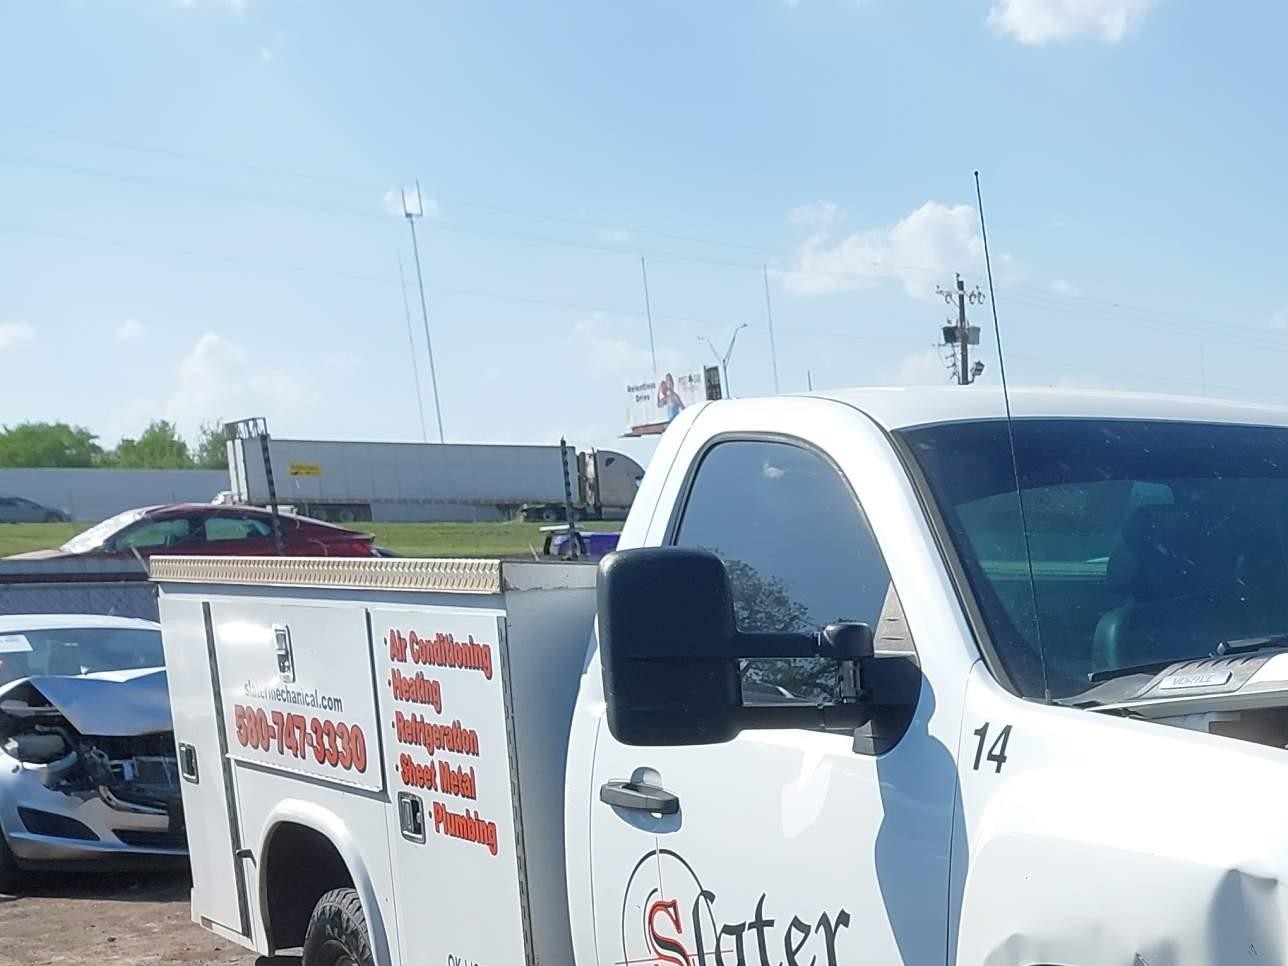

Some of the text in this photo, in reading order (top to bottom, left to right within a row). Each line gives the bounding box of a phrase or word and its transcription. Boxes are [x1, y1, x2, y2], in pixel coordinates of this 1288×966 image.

[389, 629, 493, 681] Air Conditioning
[391, 667, 442, 715] Heating
[234, 703, 367, 775] 580-747-3330
[395, 710, 480, 757] Refrigeration
[973, 721, 1012, 774] 14
[400, 752, 477, 801] Sheet Metal
[432, 801, 499, 856] Plumbing
